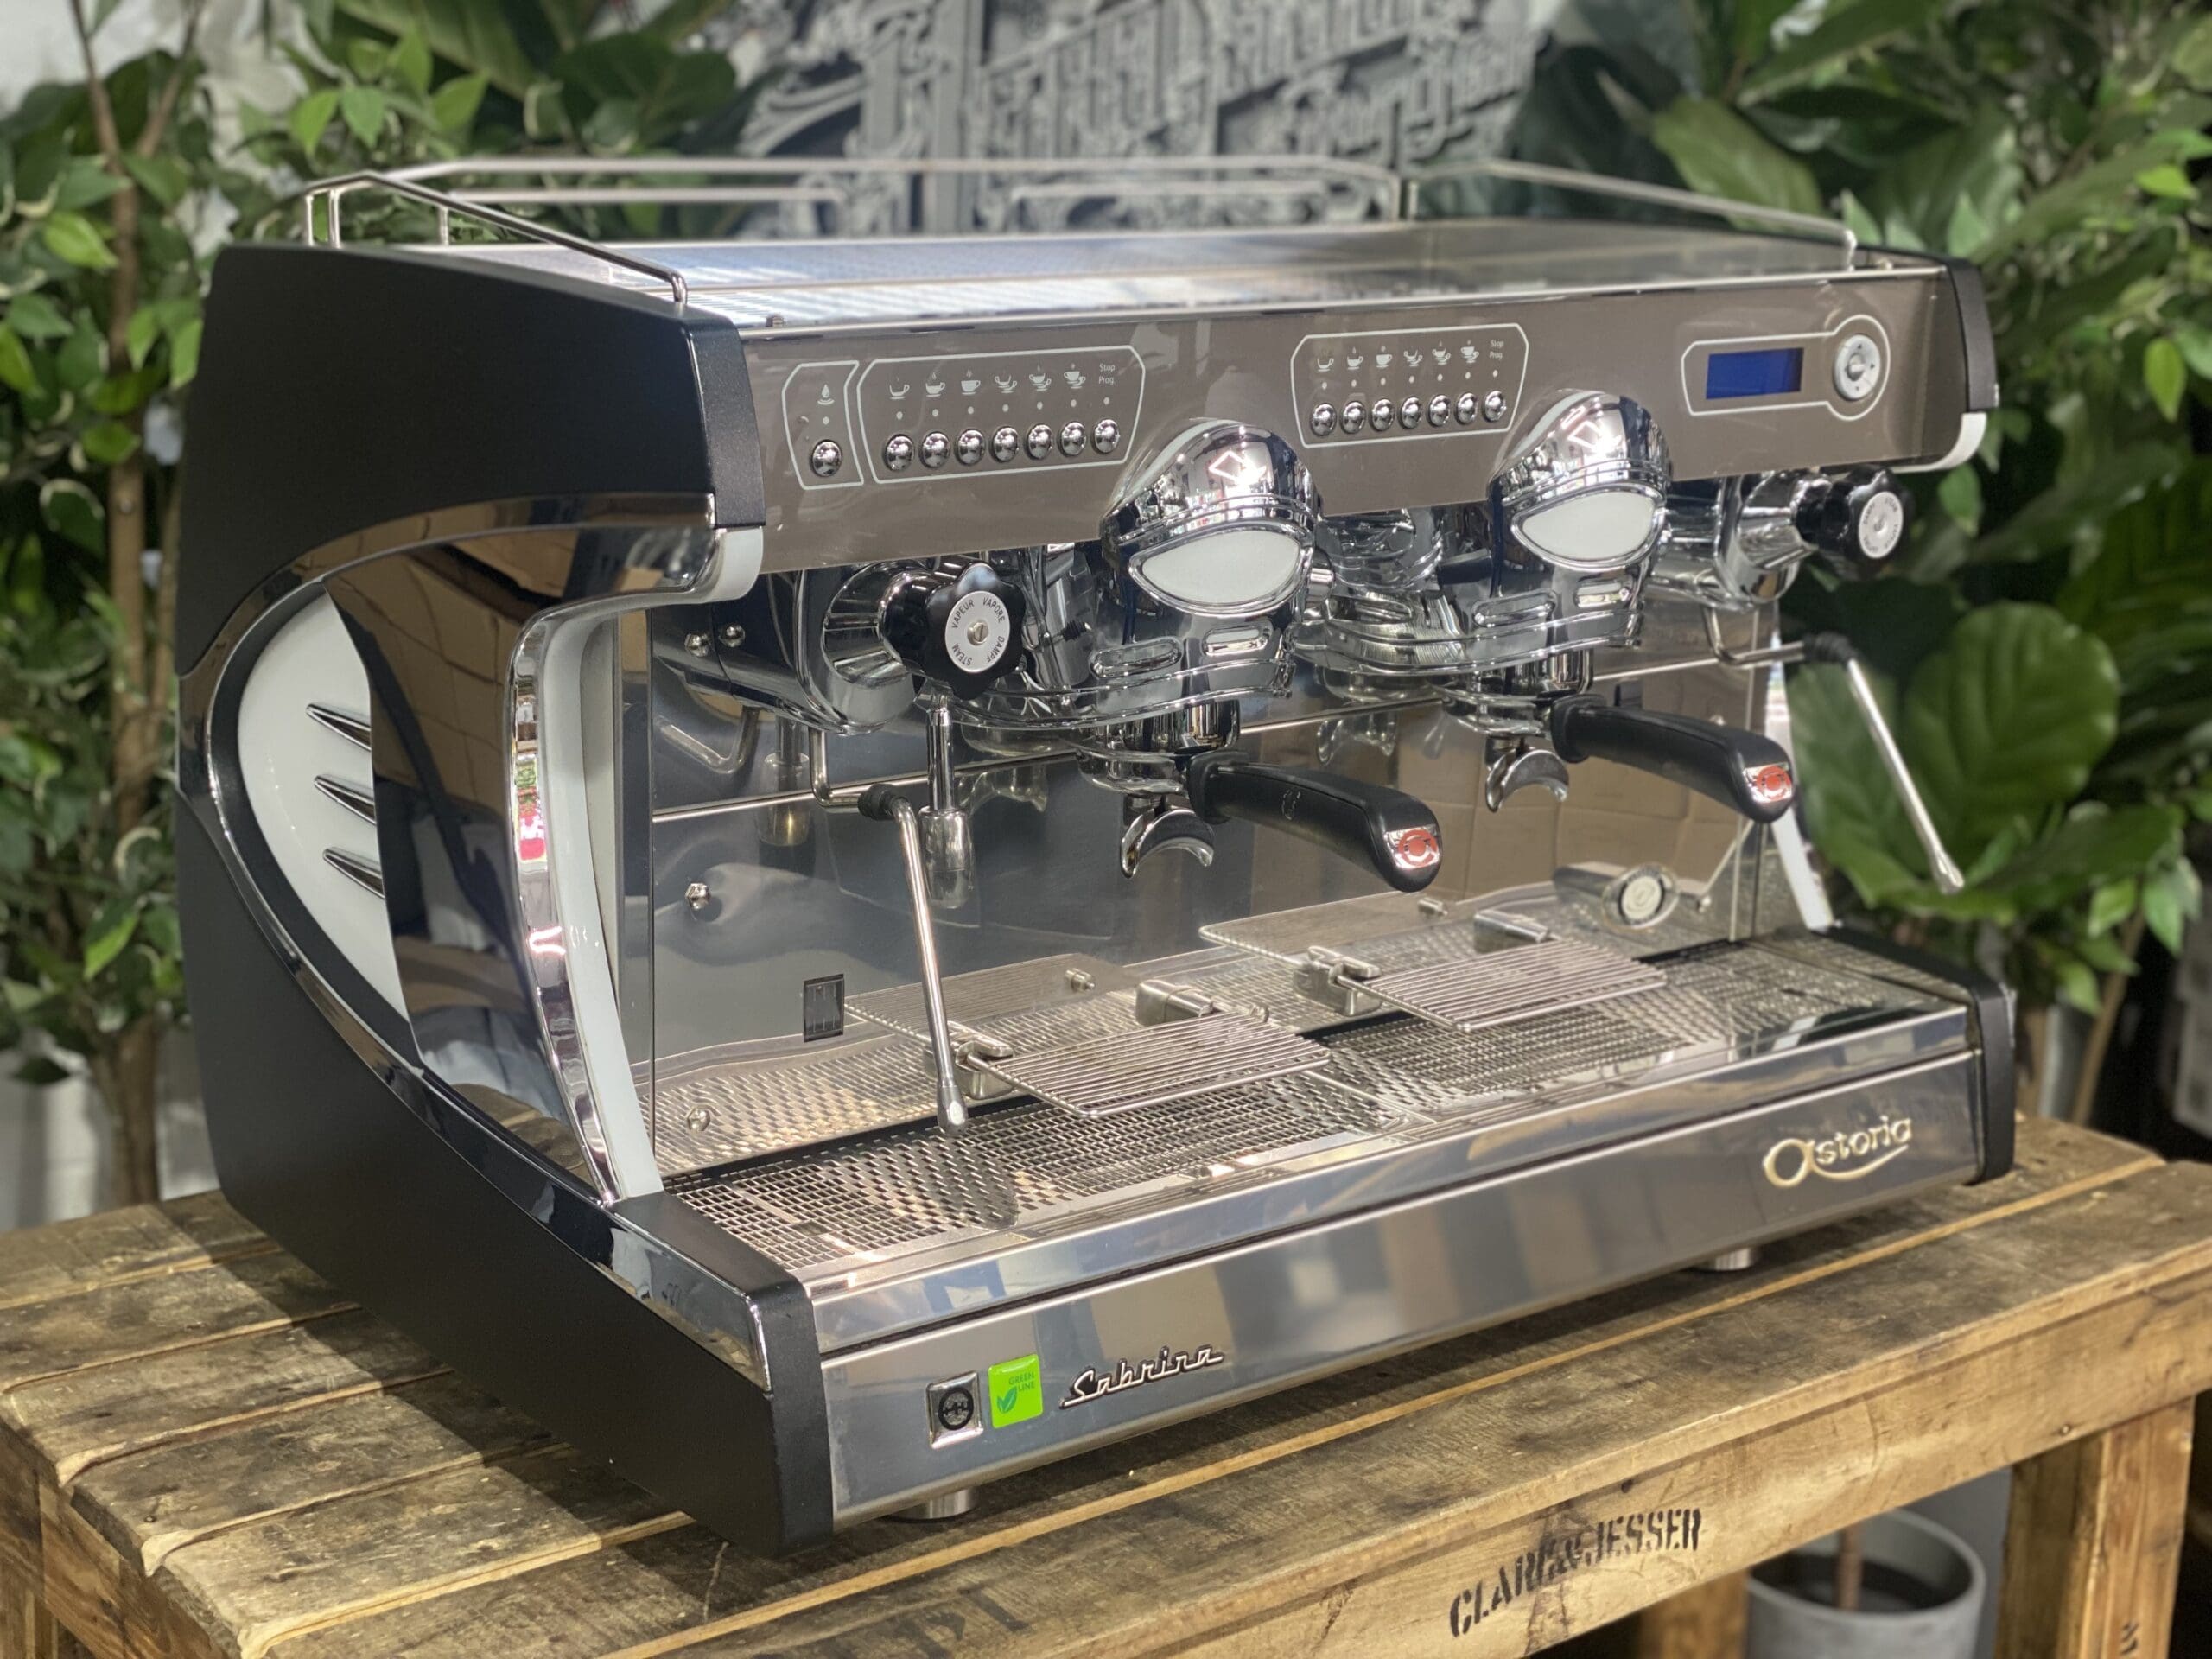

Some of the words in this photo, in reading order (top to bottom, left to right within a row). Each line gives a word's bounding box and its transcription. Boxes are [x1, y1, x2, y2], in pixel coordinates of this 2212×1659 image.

[1490, 339, 1504, 349] Stop
[1099, 363, 1116, 372] Stop
[951, 599, 975, 629] VAPEUR
[982, 597, 1006, 624] VAPORE
[951, 642, 973, 666] STEAM
[986, 635, 1006, 664] DAMPF
[1008, 1371, 1034, 1385] GREEN
[1018, 1381, 1034, 1392] LINE
[1058, 1344, 1226, 1410] Sabrina
